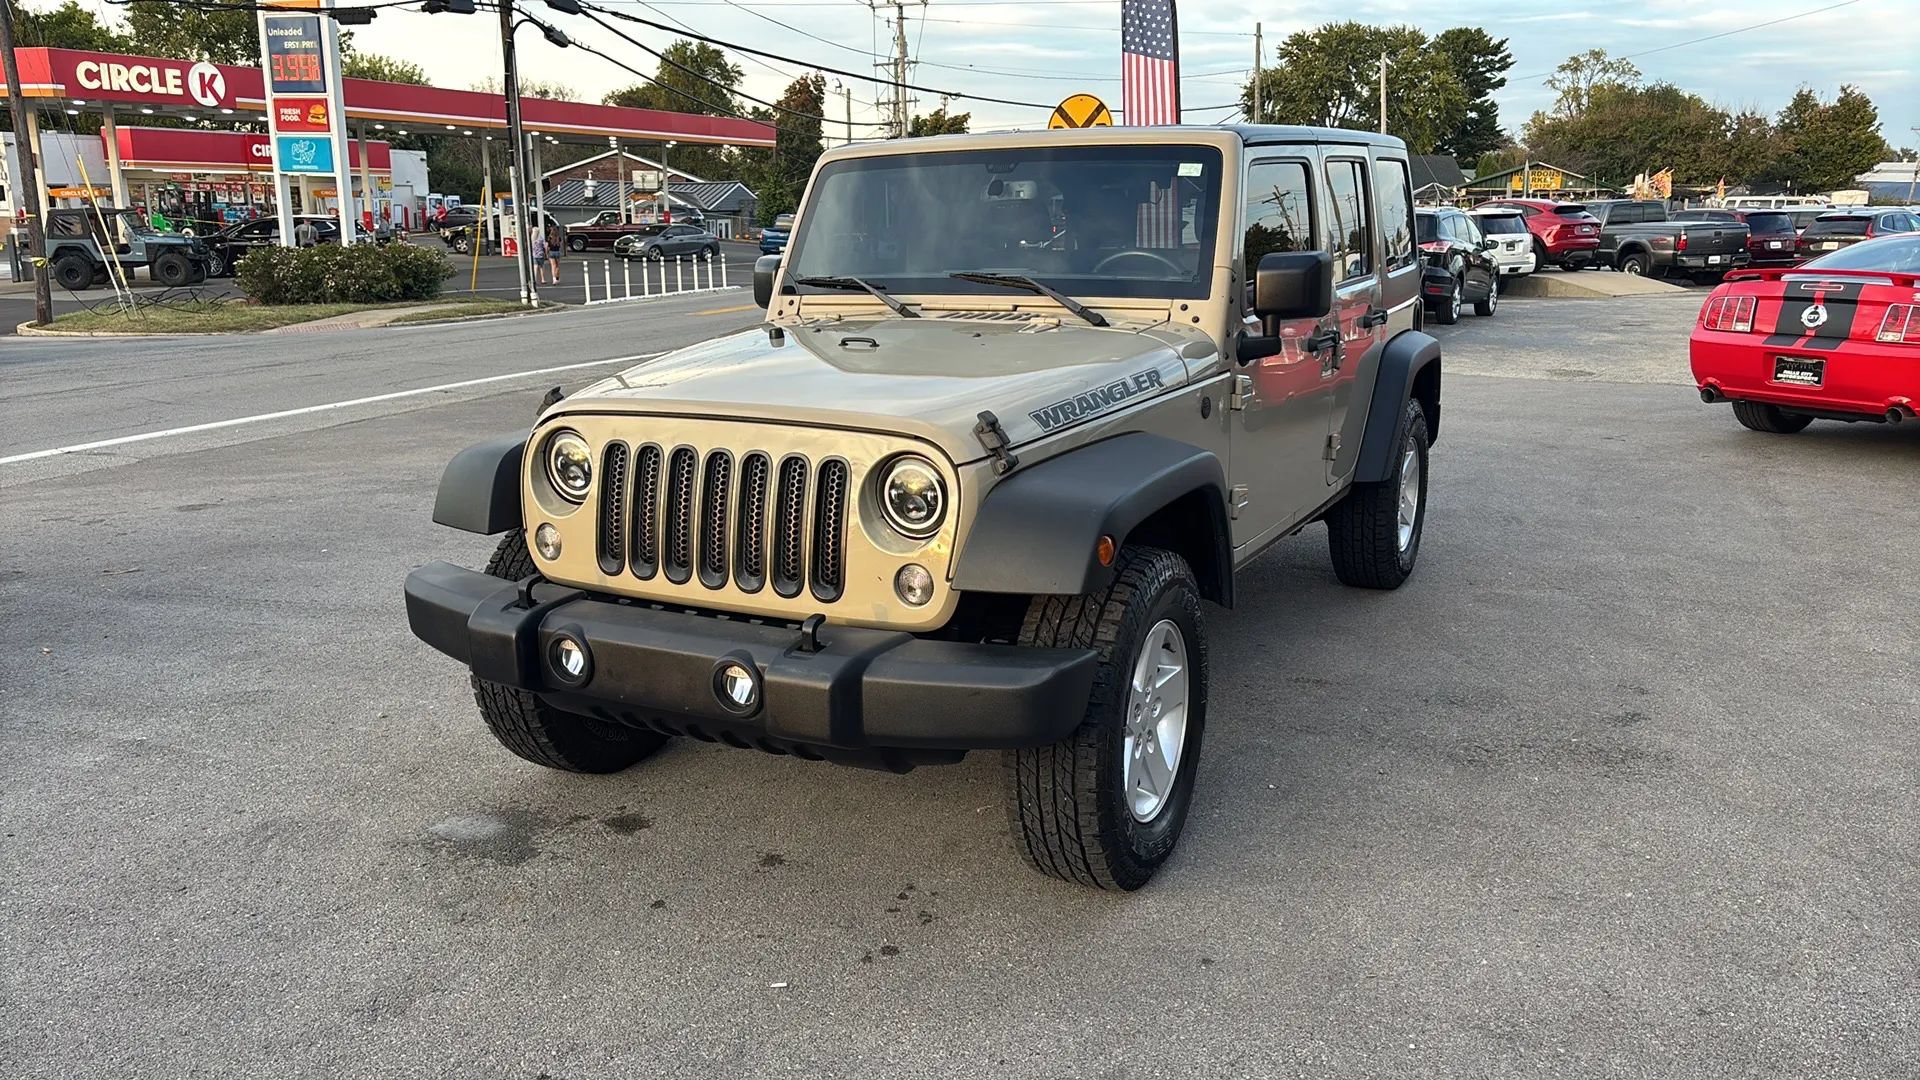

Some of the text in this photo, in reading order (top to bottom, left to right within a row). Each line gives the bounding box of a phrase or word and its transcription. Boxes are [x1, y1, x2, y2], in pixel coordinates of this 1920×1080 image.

[268, 28, 303, 36] Unleaded
[76, 61, 226, 106] CIRCLE K
[253, 143, 273, 157] CIR
[1028, 367, 1166, 433] WRANGLER
